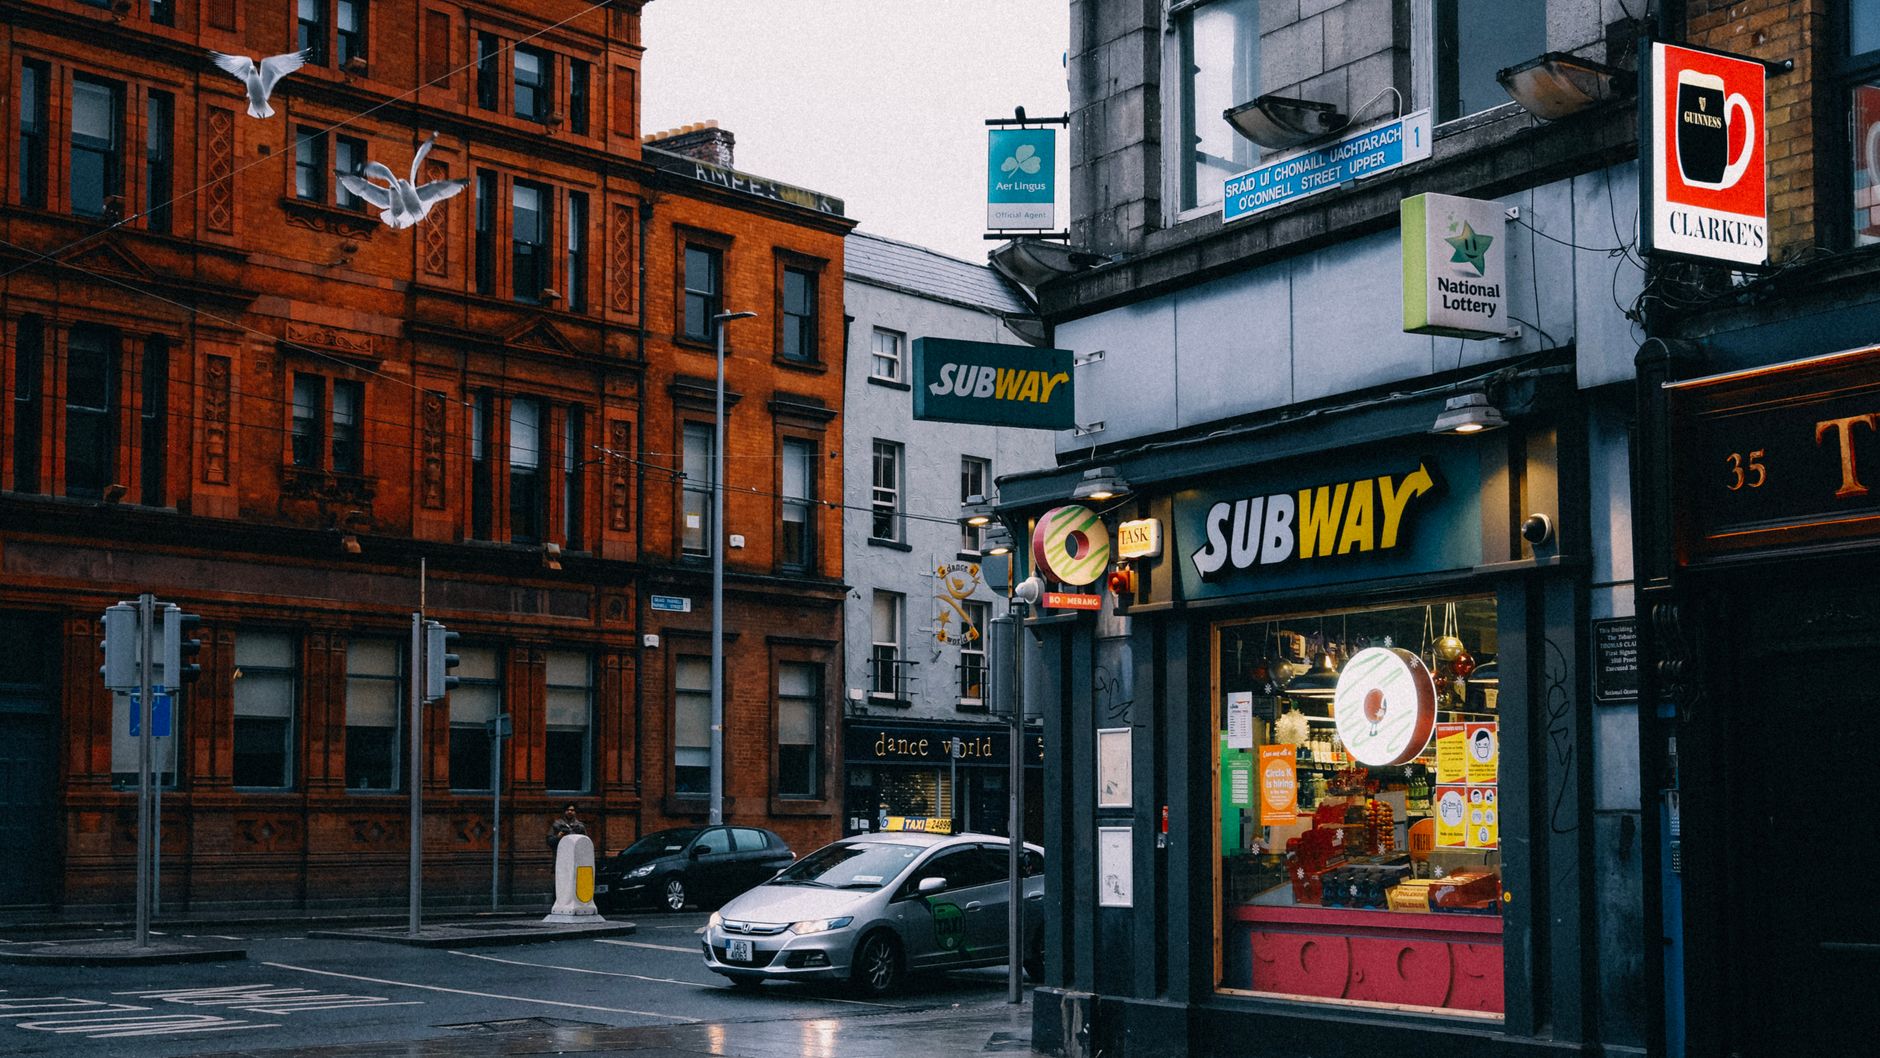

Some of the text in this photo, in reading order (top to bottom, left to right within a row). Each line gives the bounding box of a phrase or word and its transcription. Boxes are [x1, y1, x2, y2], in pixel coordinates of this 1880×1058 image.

[1684, 111, 1722, 129] GUINNESS
[1225, 126, 1420, 199] SRÁID UÍ CHONAILL UACHTARACH 1
[996, 181, 1046, 192] Aer Lingus
[1238, 151, 1386, 211] O'CONNELL STREET UPPER
[995, 211, 1047, 220] Official Agent
[1669, 210, 1764, 249] CLARKE'S
[1437, 277, 1501, 297] National
[1443, 295, 1497, 318] Lottery
[930, 362, 1069, 404] SUBWAY
[1726, 448, 1768, 492] 35
[1191, 463, 1434, 578] SUBWAY
[1119, 526, 1149, 545] TASK
[946, 564, 968, 572] dance
[1049, 595, 1099, 606] BOMERANG
[874, 731, 929, 757] dance
[941, 736, 994, 759] world
[905, 818, 926, 831] TAXI
